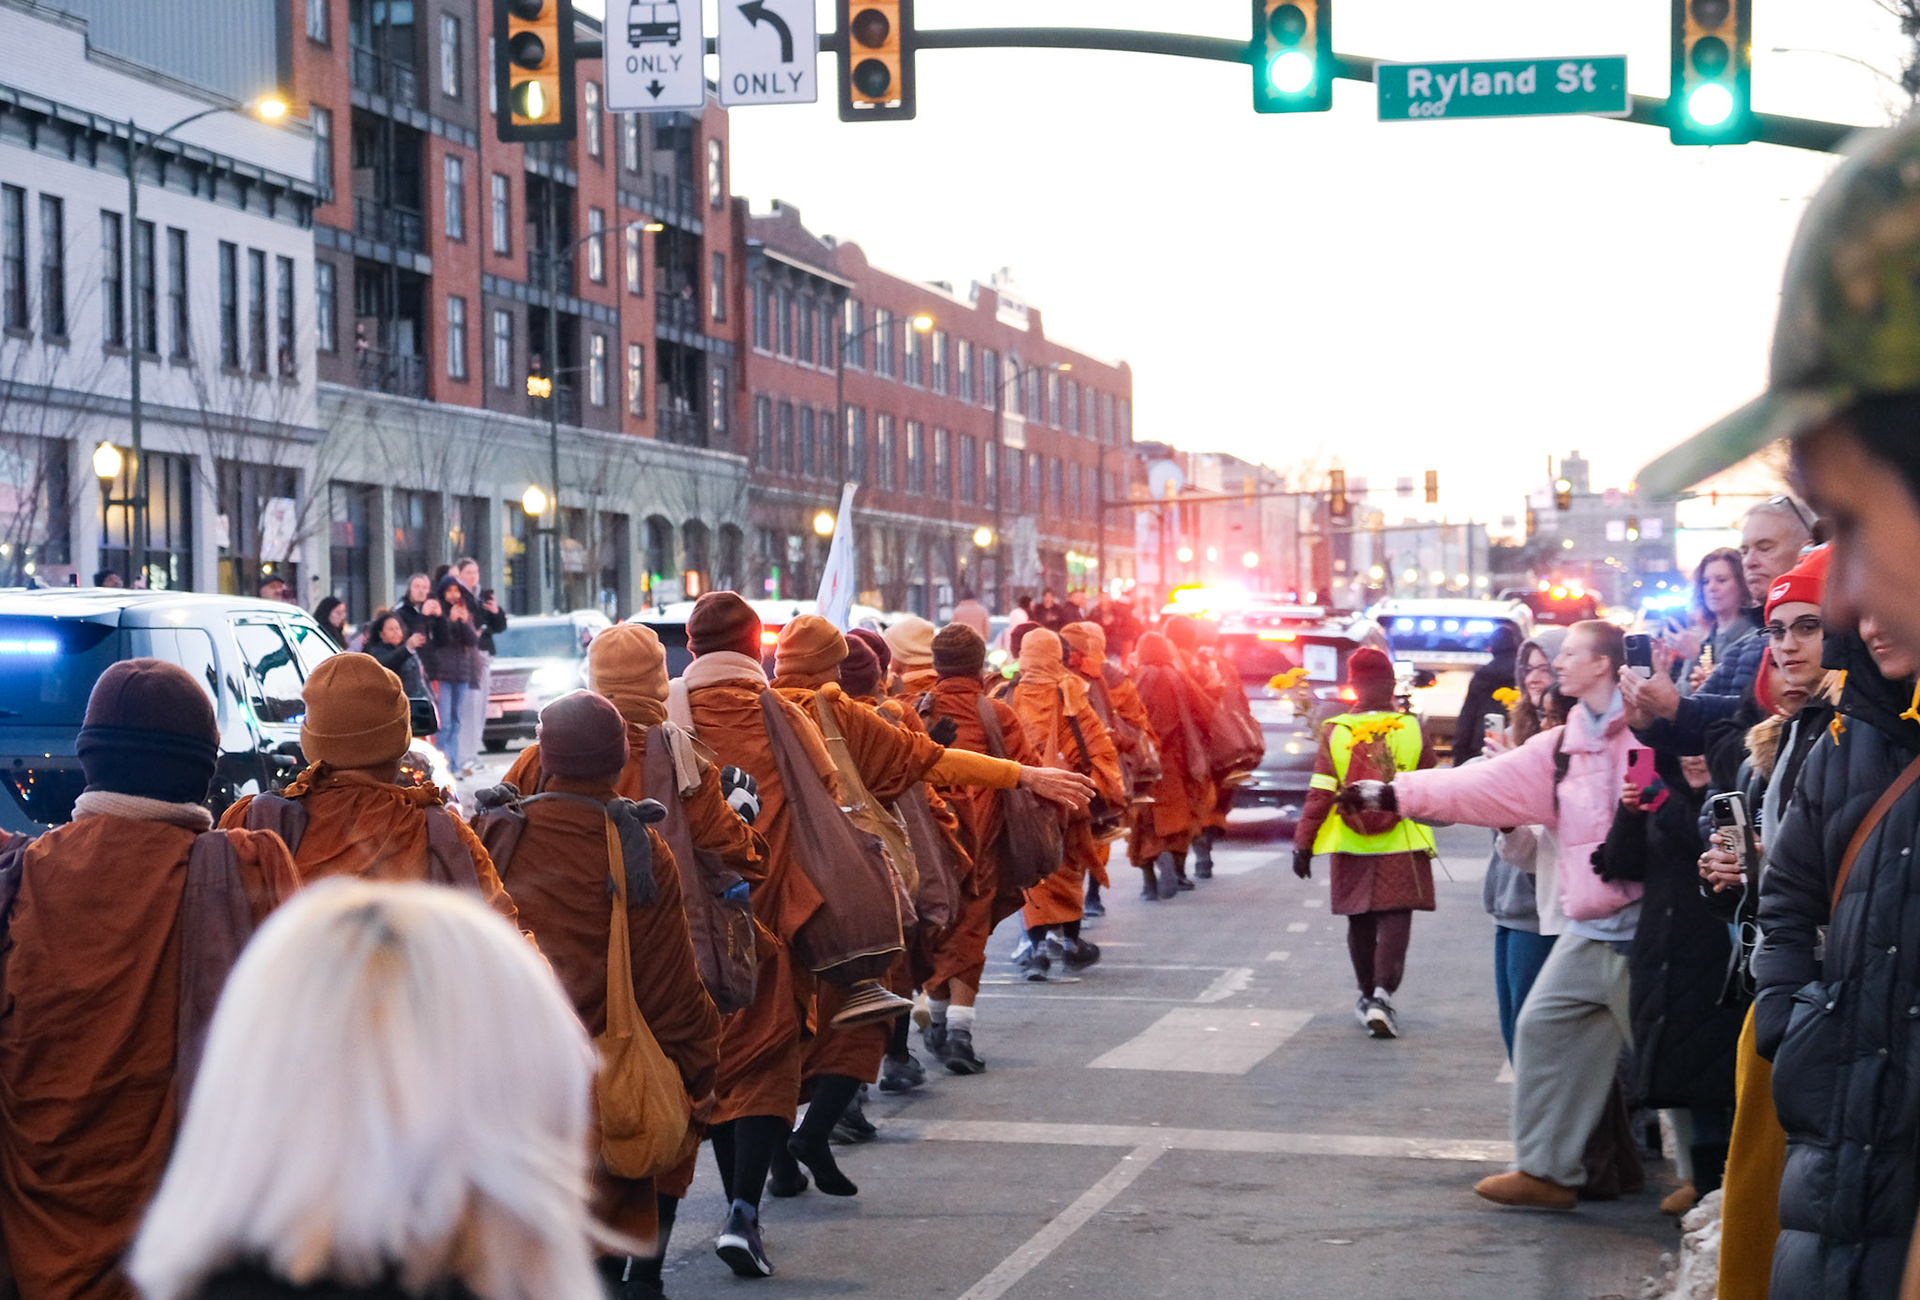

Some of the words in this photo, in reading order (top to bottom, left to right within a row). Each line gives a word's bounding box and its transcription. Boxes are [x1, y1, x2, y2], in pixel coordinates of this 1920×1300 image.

[626, 55, 683, 73] ONLY
[733, 71, 803, 95] ONLY
[1407, 65, 1536, 102] Ryland
[1555, 62, 1597, 93] St
[1408, 101, 1446, 117] 600
